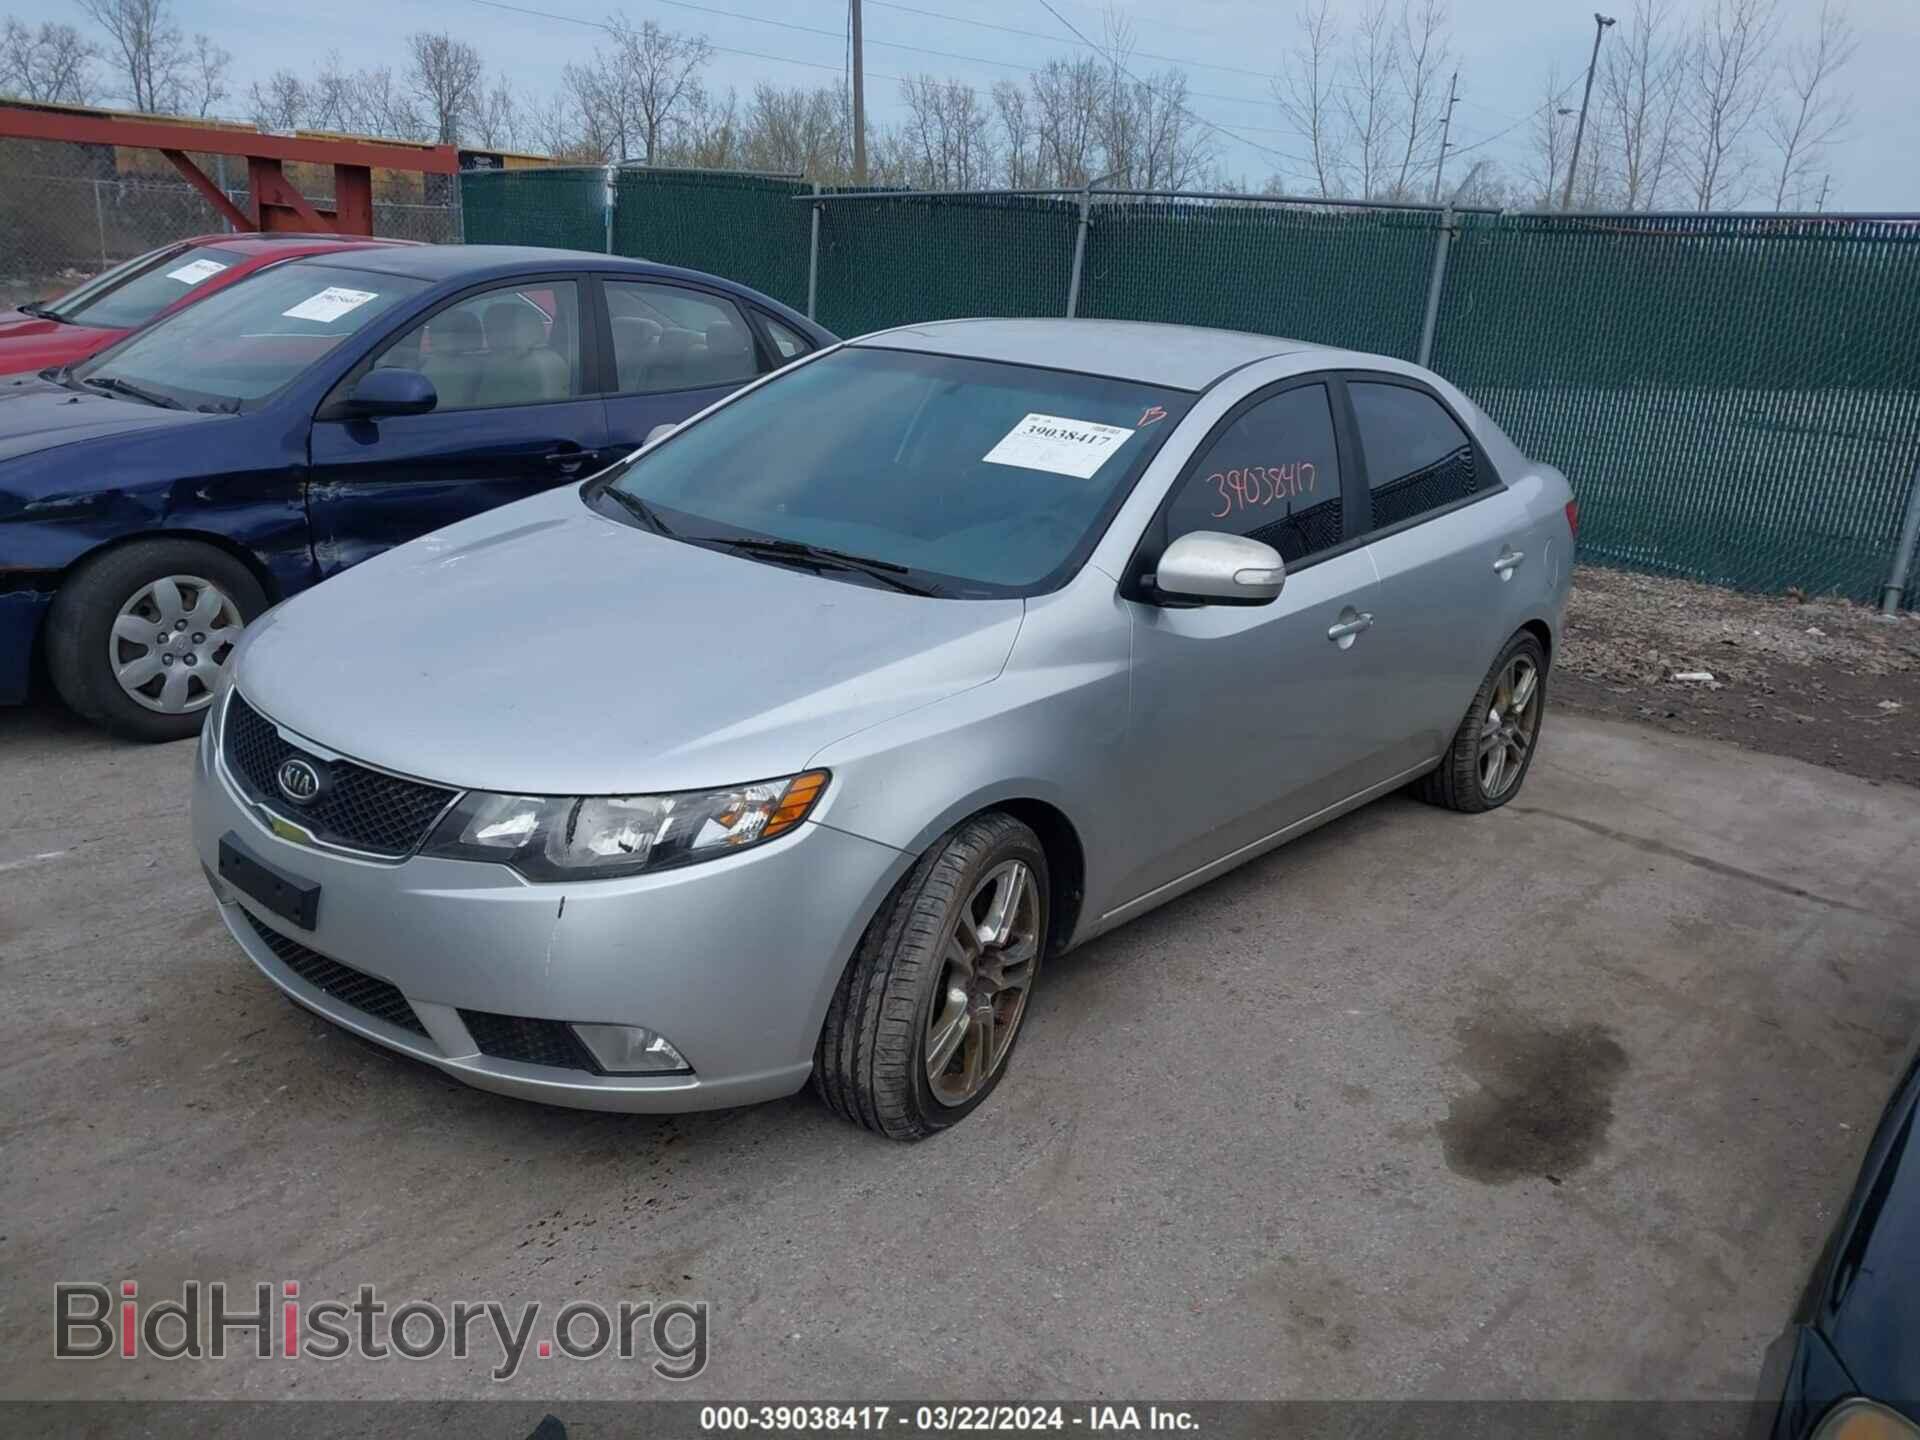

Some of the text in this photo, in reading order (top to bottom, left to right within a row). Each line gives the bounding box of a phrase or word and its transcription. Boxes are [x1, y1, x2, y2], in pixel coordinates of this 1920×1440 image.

[1022, 425, 1112, 446] 39038417
[1205, 462, 1316, 518] 39038417
[281, 763, 314, 796] KIA
